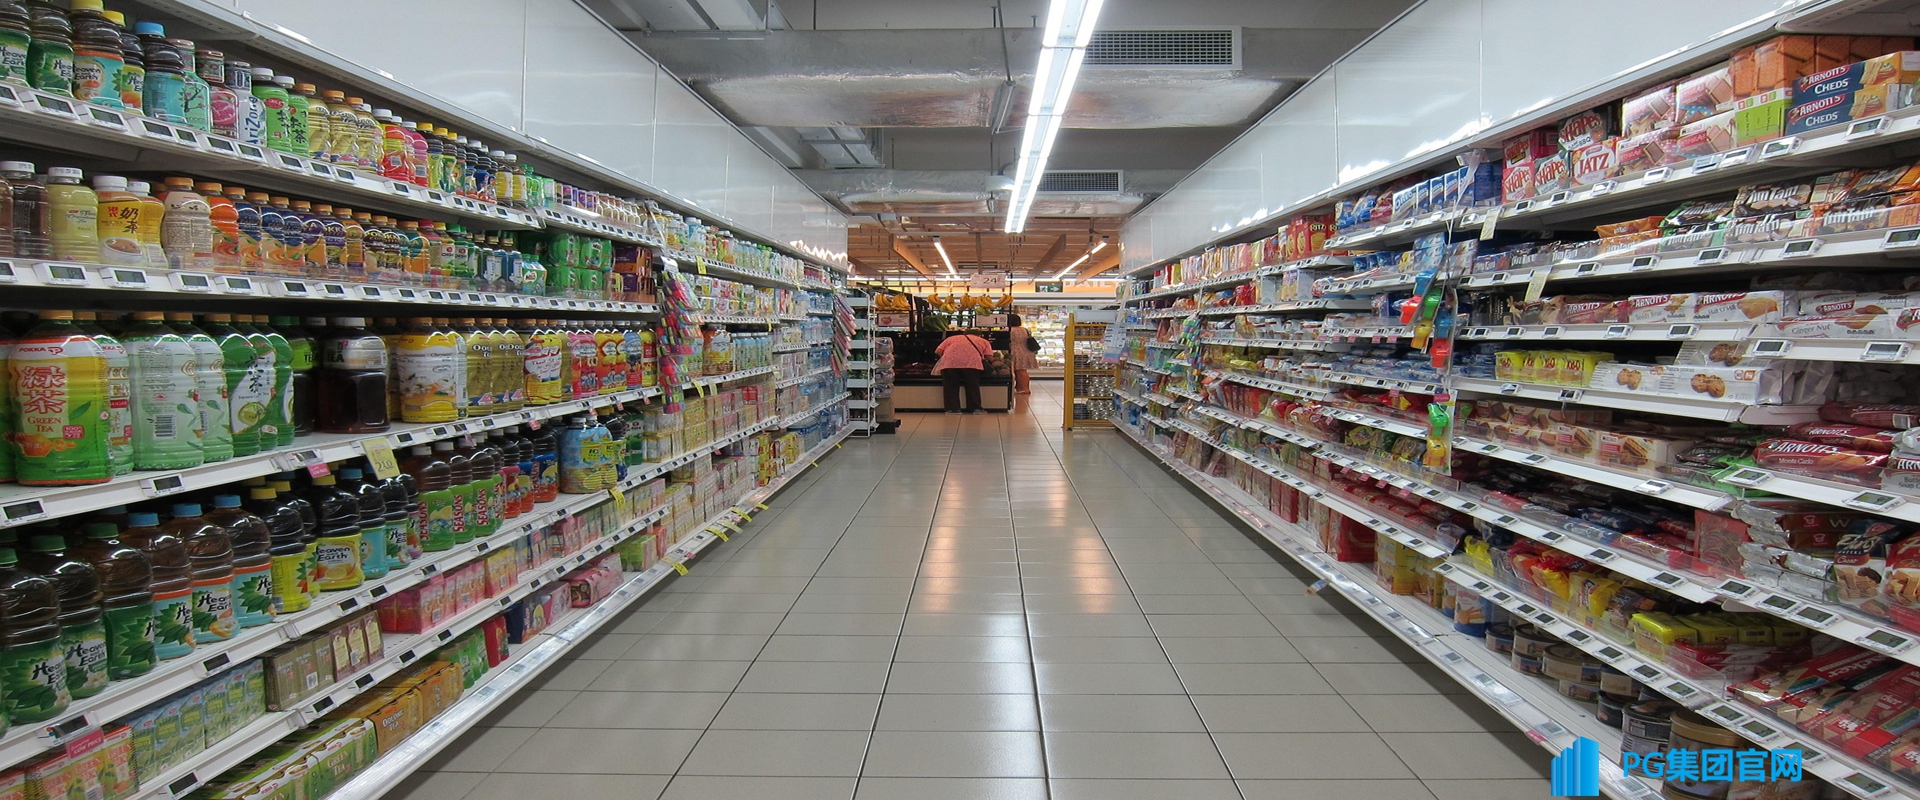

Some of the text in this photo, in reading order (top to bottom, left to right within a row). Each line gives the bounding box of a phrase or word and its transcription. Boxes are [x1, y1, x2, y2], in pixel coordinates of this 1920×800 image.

[1808, 65, 1847, 84] ARNOTT'S
[1814, 78, 1849, 95] CHEDS
[1800, 94, 1841, 116] ARNOTT'S
[1805, 111, 1838, 127] CHEDS
[1577, 152, 1610, 178] JATZ
[1395, 191, 1413, 210] OREO
[1635, 295, 1668, 308] ARNOTT'S
[1823, 301, 1852, 313] ARNOTT'S
[1635, 312, 1650, 321] Teddy
[1791, 323, 1831, 335] Ginger Nut
[27, 416, 62, 425] GREEN
[35, 425, 54, 433] TEA
[1774, 441, 1838, 454] ARNOTT'S
[1779, 457, 1797, 465] Monte
[477, 487, 489, 526] SEASONS
[452, 494, 465, 533] SEASONS
[317, 553, 348, 562] Earth
[333, 765, 346, 776] TEA
